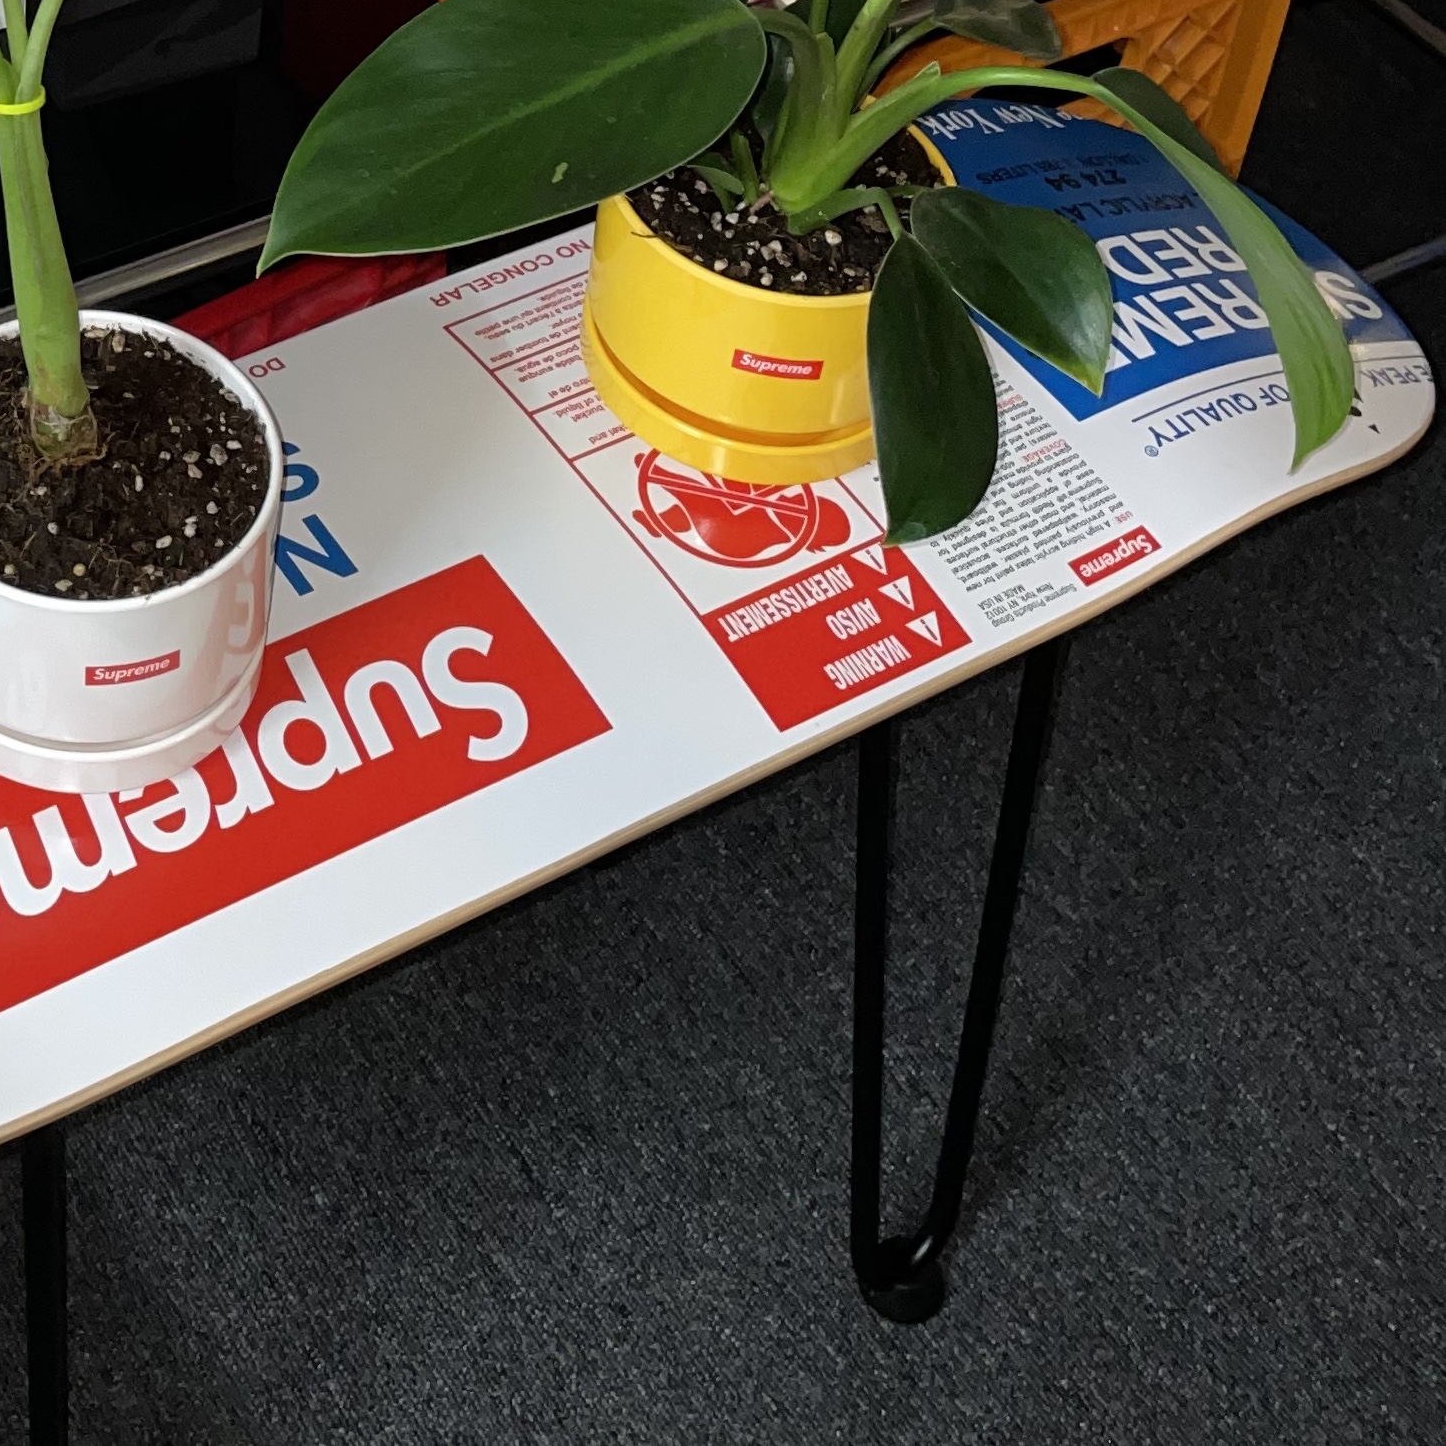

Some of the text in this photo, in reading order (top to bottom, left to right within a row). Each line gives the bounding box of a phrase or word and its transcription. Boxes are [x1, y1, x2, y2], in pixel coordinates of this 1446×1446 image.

[917, 101, 1065, 140] New York
[429, 239, 590, 308] NO CONGELAR
[1097, 223, 1248, 286] RED
[249, 356, 286, 378] DO
[740, 353, 813, 375] Supreme
[1365, 364, 1417, 389] PEAK
[1080, 530, 1153, 580] Supreme
[719, 563, 853, 643] AVERTISSEMENT
[827, 597, 882, 640] AVISO
[93, 656, 171, 683] Supreme
[824, 635, 912, 690] WARNING
